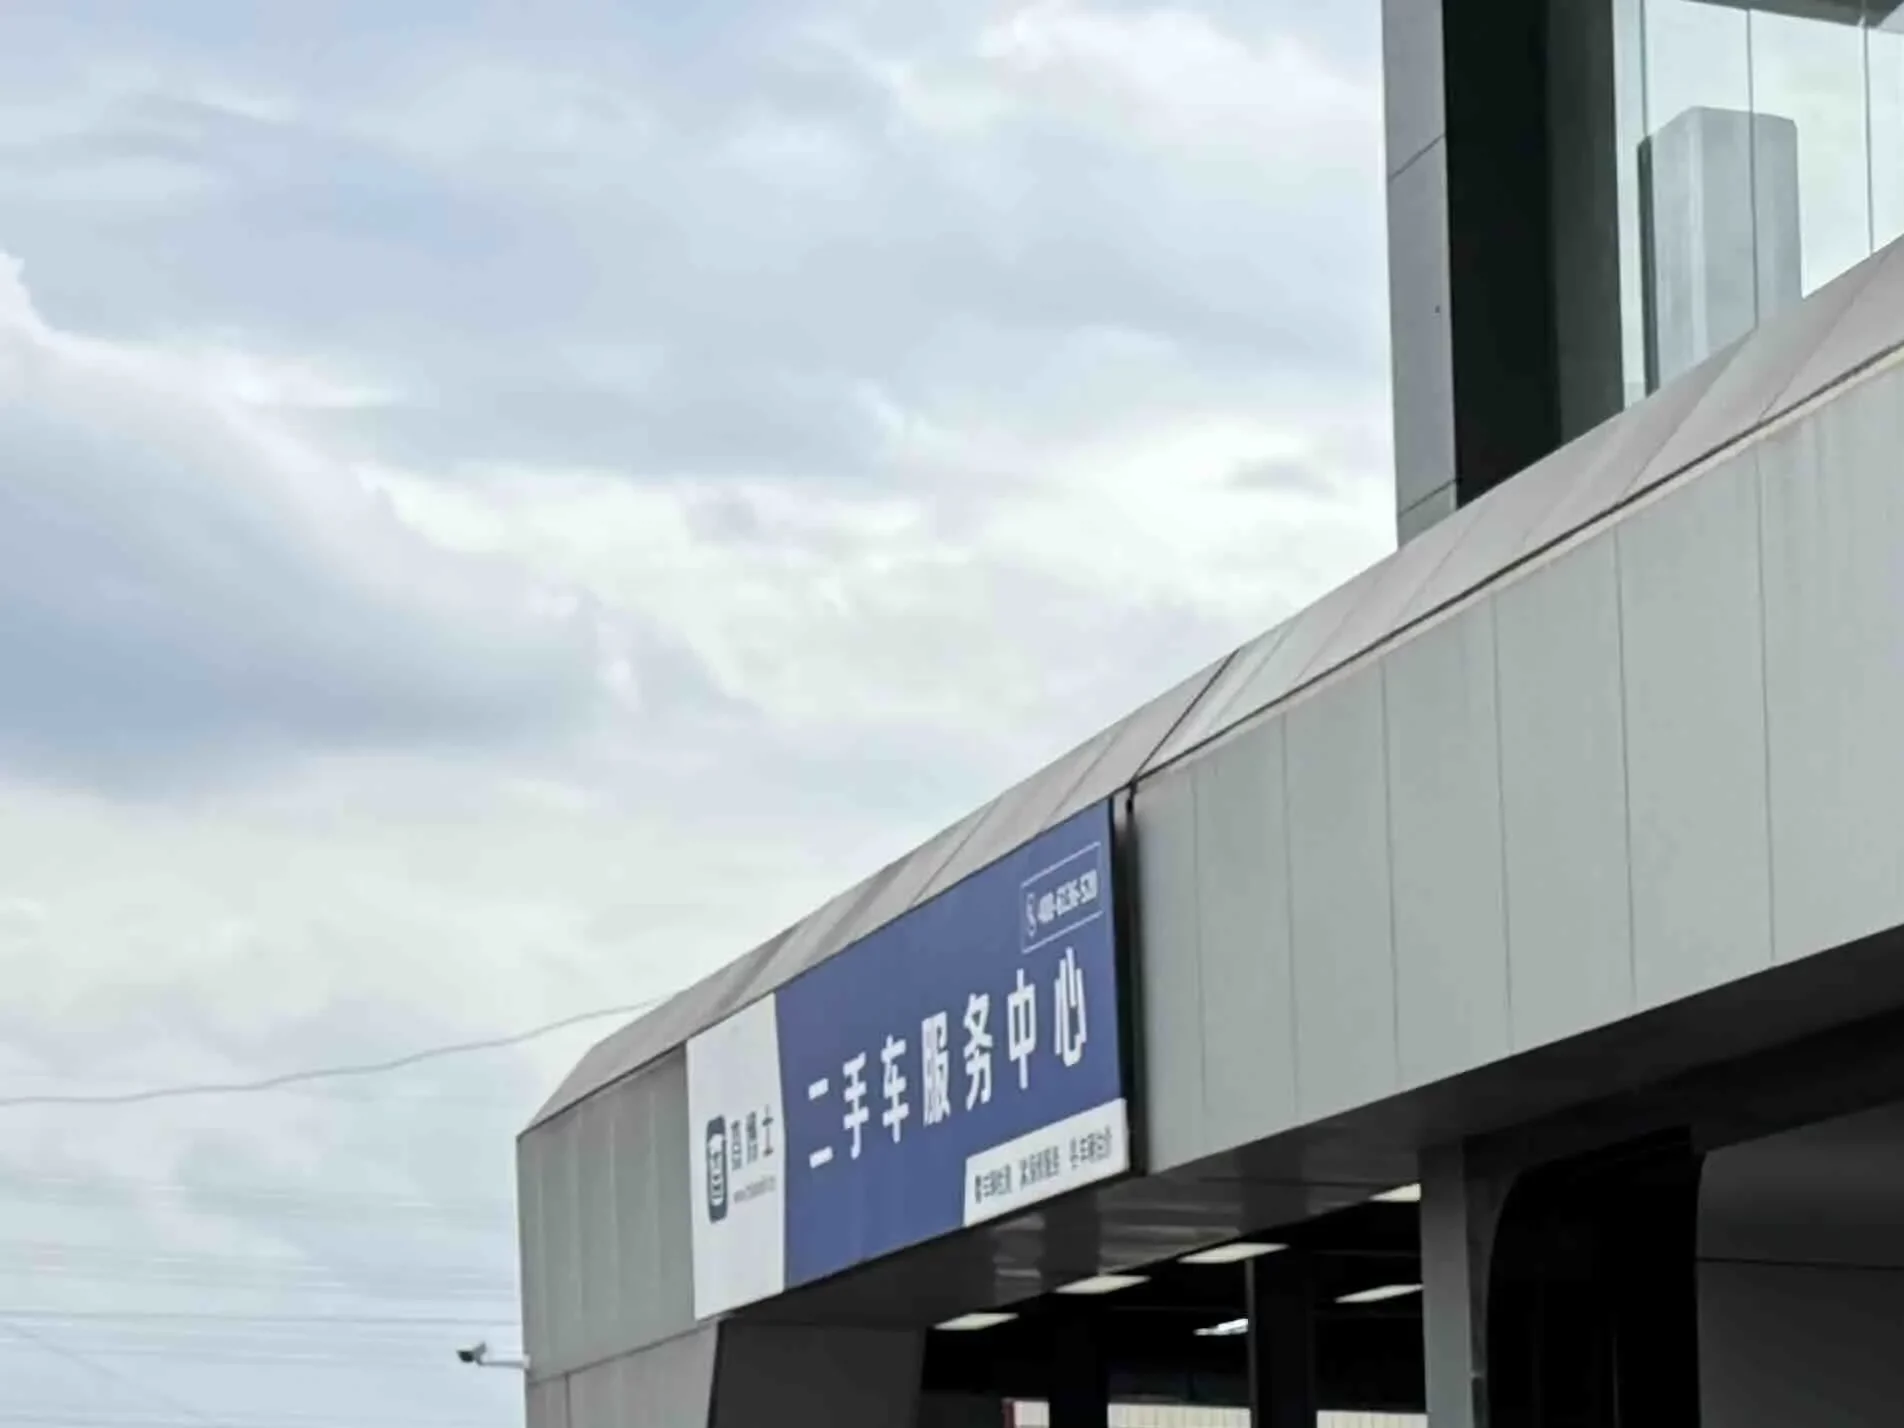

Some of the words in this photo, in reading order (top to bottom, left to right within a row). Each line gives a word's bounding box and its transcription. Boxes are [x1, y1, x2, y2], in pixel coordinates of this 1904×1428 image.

[808, 946, 1088, 1169] 二手车服务中心
